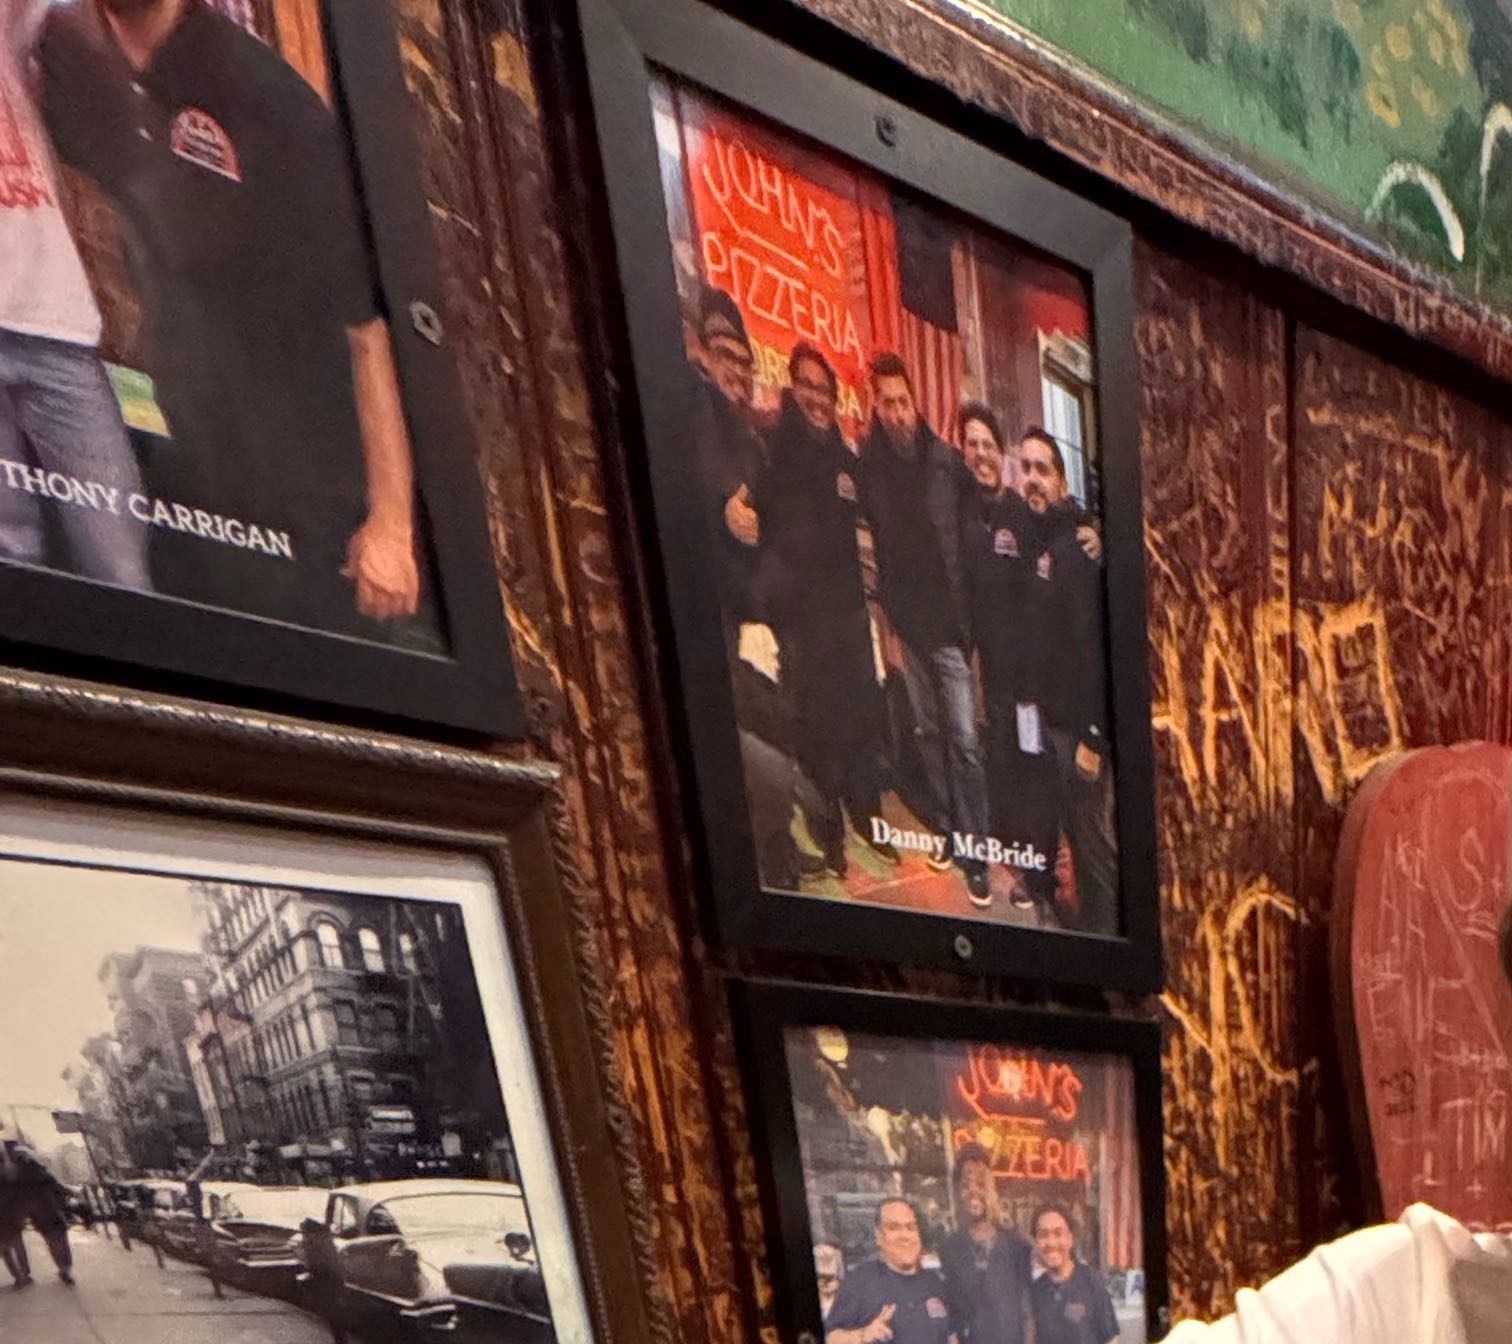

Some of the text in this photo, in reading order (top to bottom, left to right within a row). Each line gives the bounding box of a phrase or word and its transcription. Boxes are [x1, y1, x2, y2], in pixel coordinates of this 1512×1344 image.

[0, 459, 294, 560] THONY CARRIGAN
[869, 816, 1048, 871] Danny McBride
